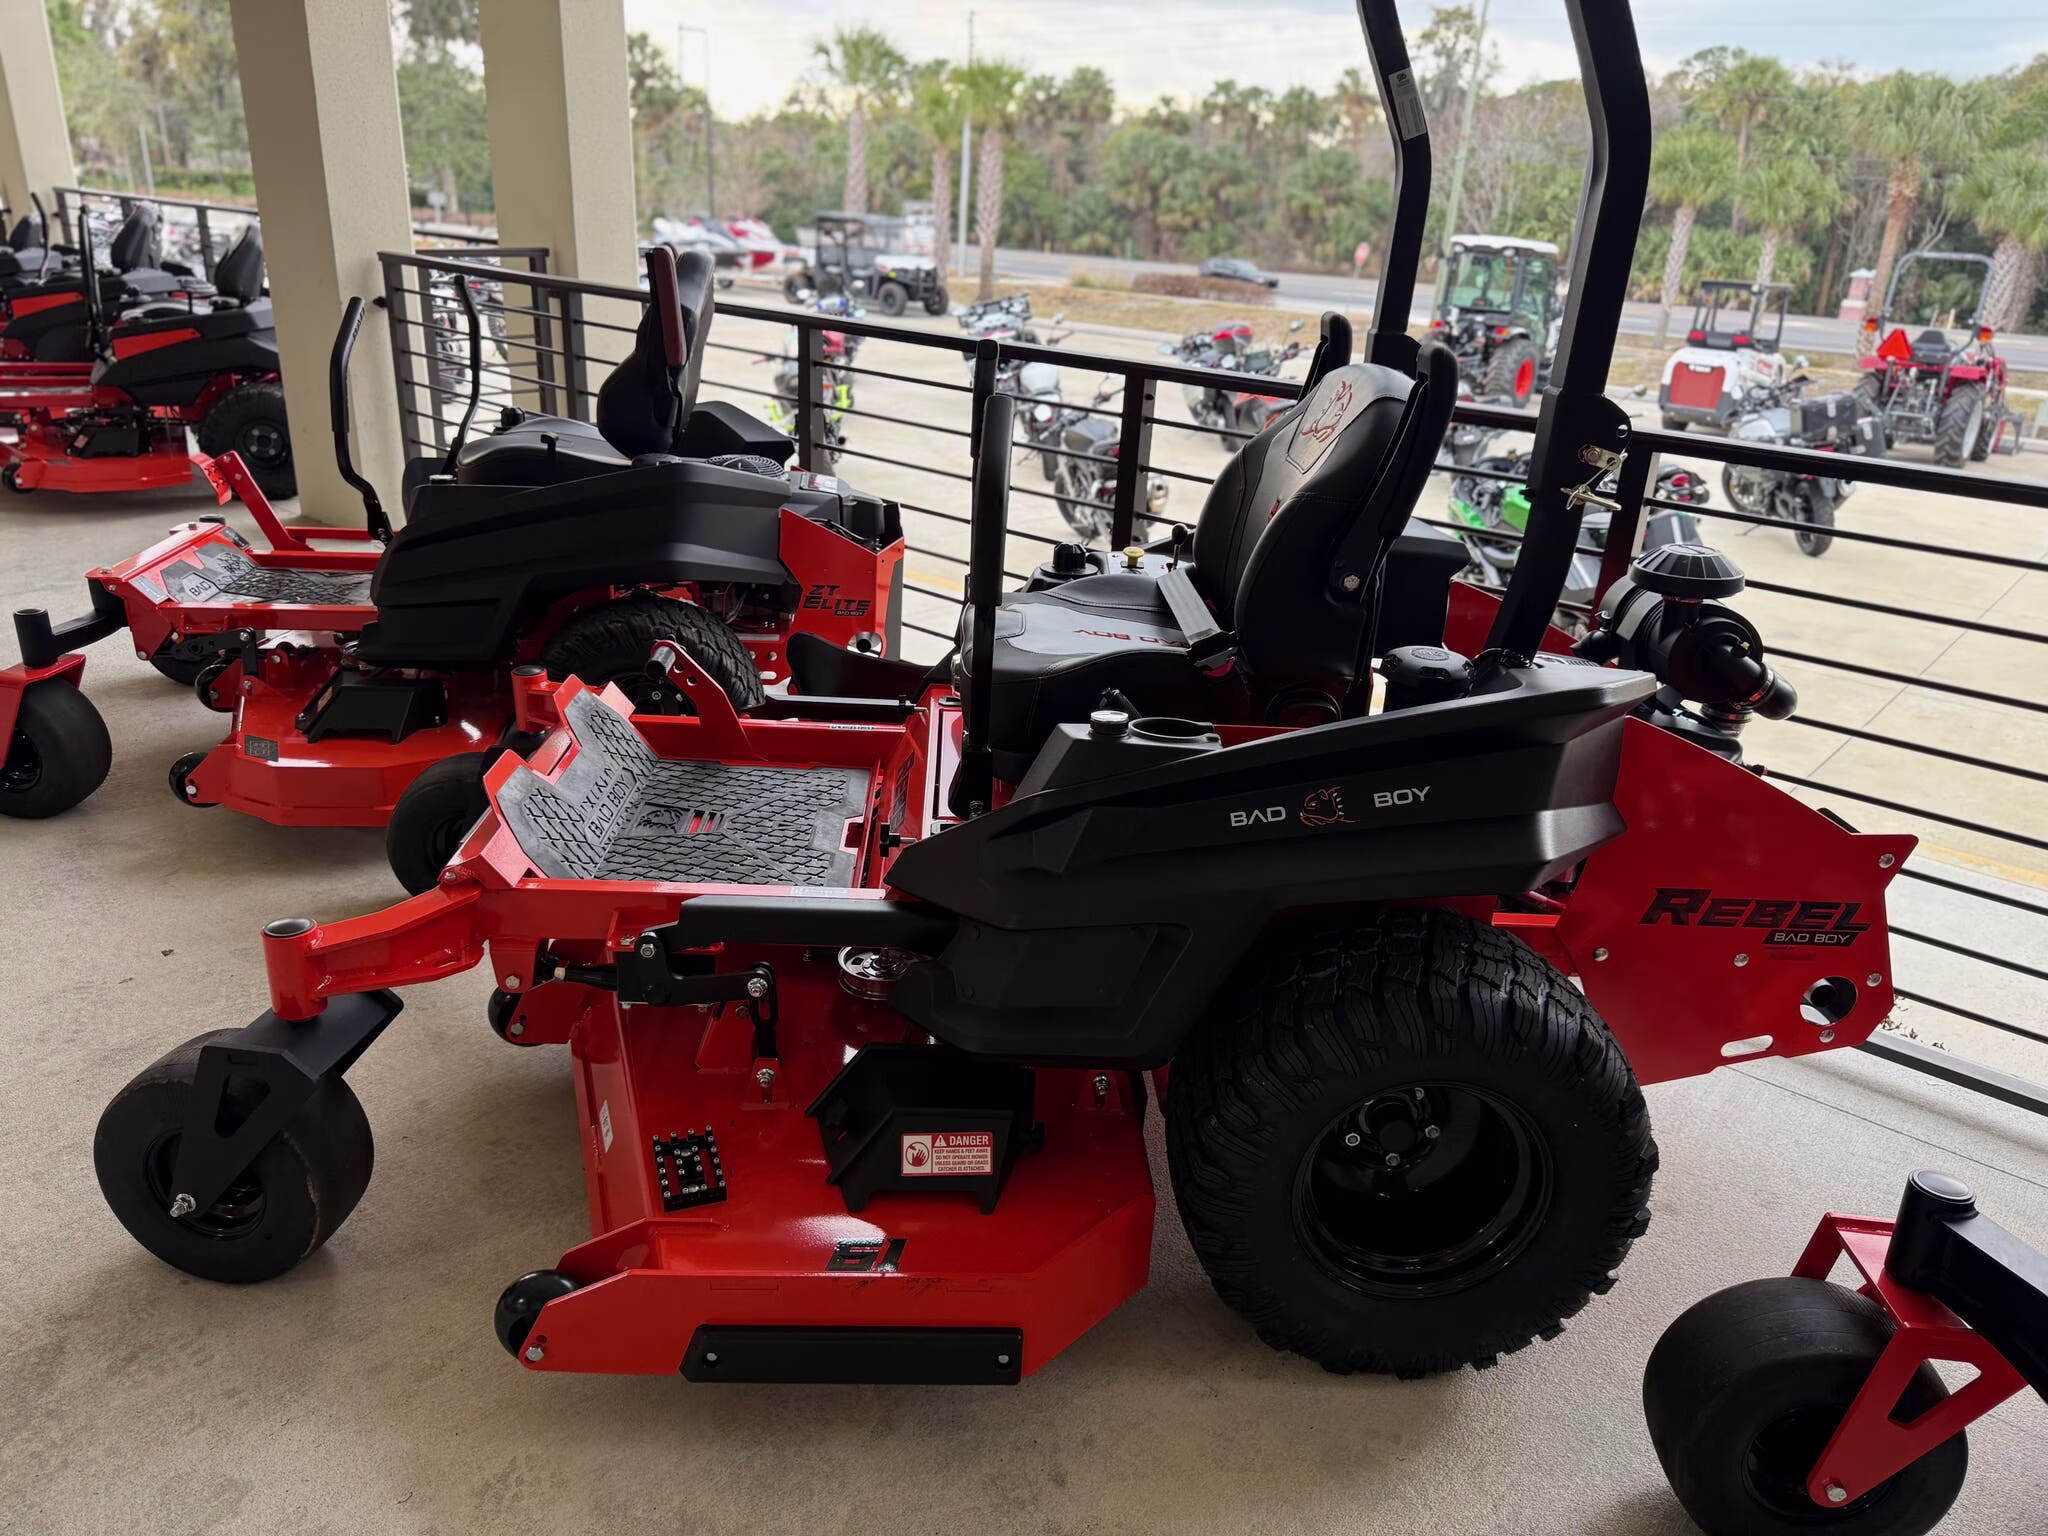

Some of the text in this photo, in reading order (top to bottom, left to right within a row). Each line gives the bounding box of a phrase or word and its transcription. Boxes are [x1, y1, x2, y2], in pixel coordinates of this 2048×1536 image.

[809, 584, 840, 596] ZT
[803, 595, 872, 610] ELITE
[1073, 629, 1132, 641] BOY
[588, 774, 631, 839] BAD BOY
[1230, 786, 1430, 827] BAD BOY
[1639, 887, 1872, 931] REBEL
[1774, 932, 1851, 944] BAD BOY
[949, 1135, 989, 1146] DANGER
[825, 1238, 907, 1271] 61
